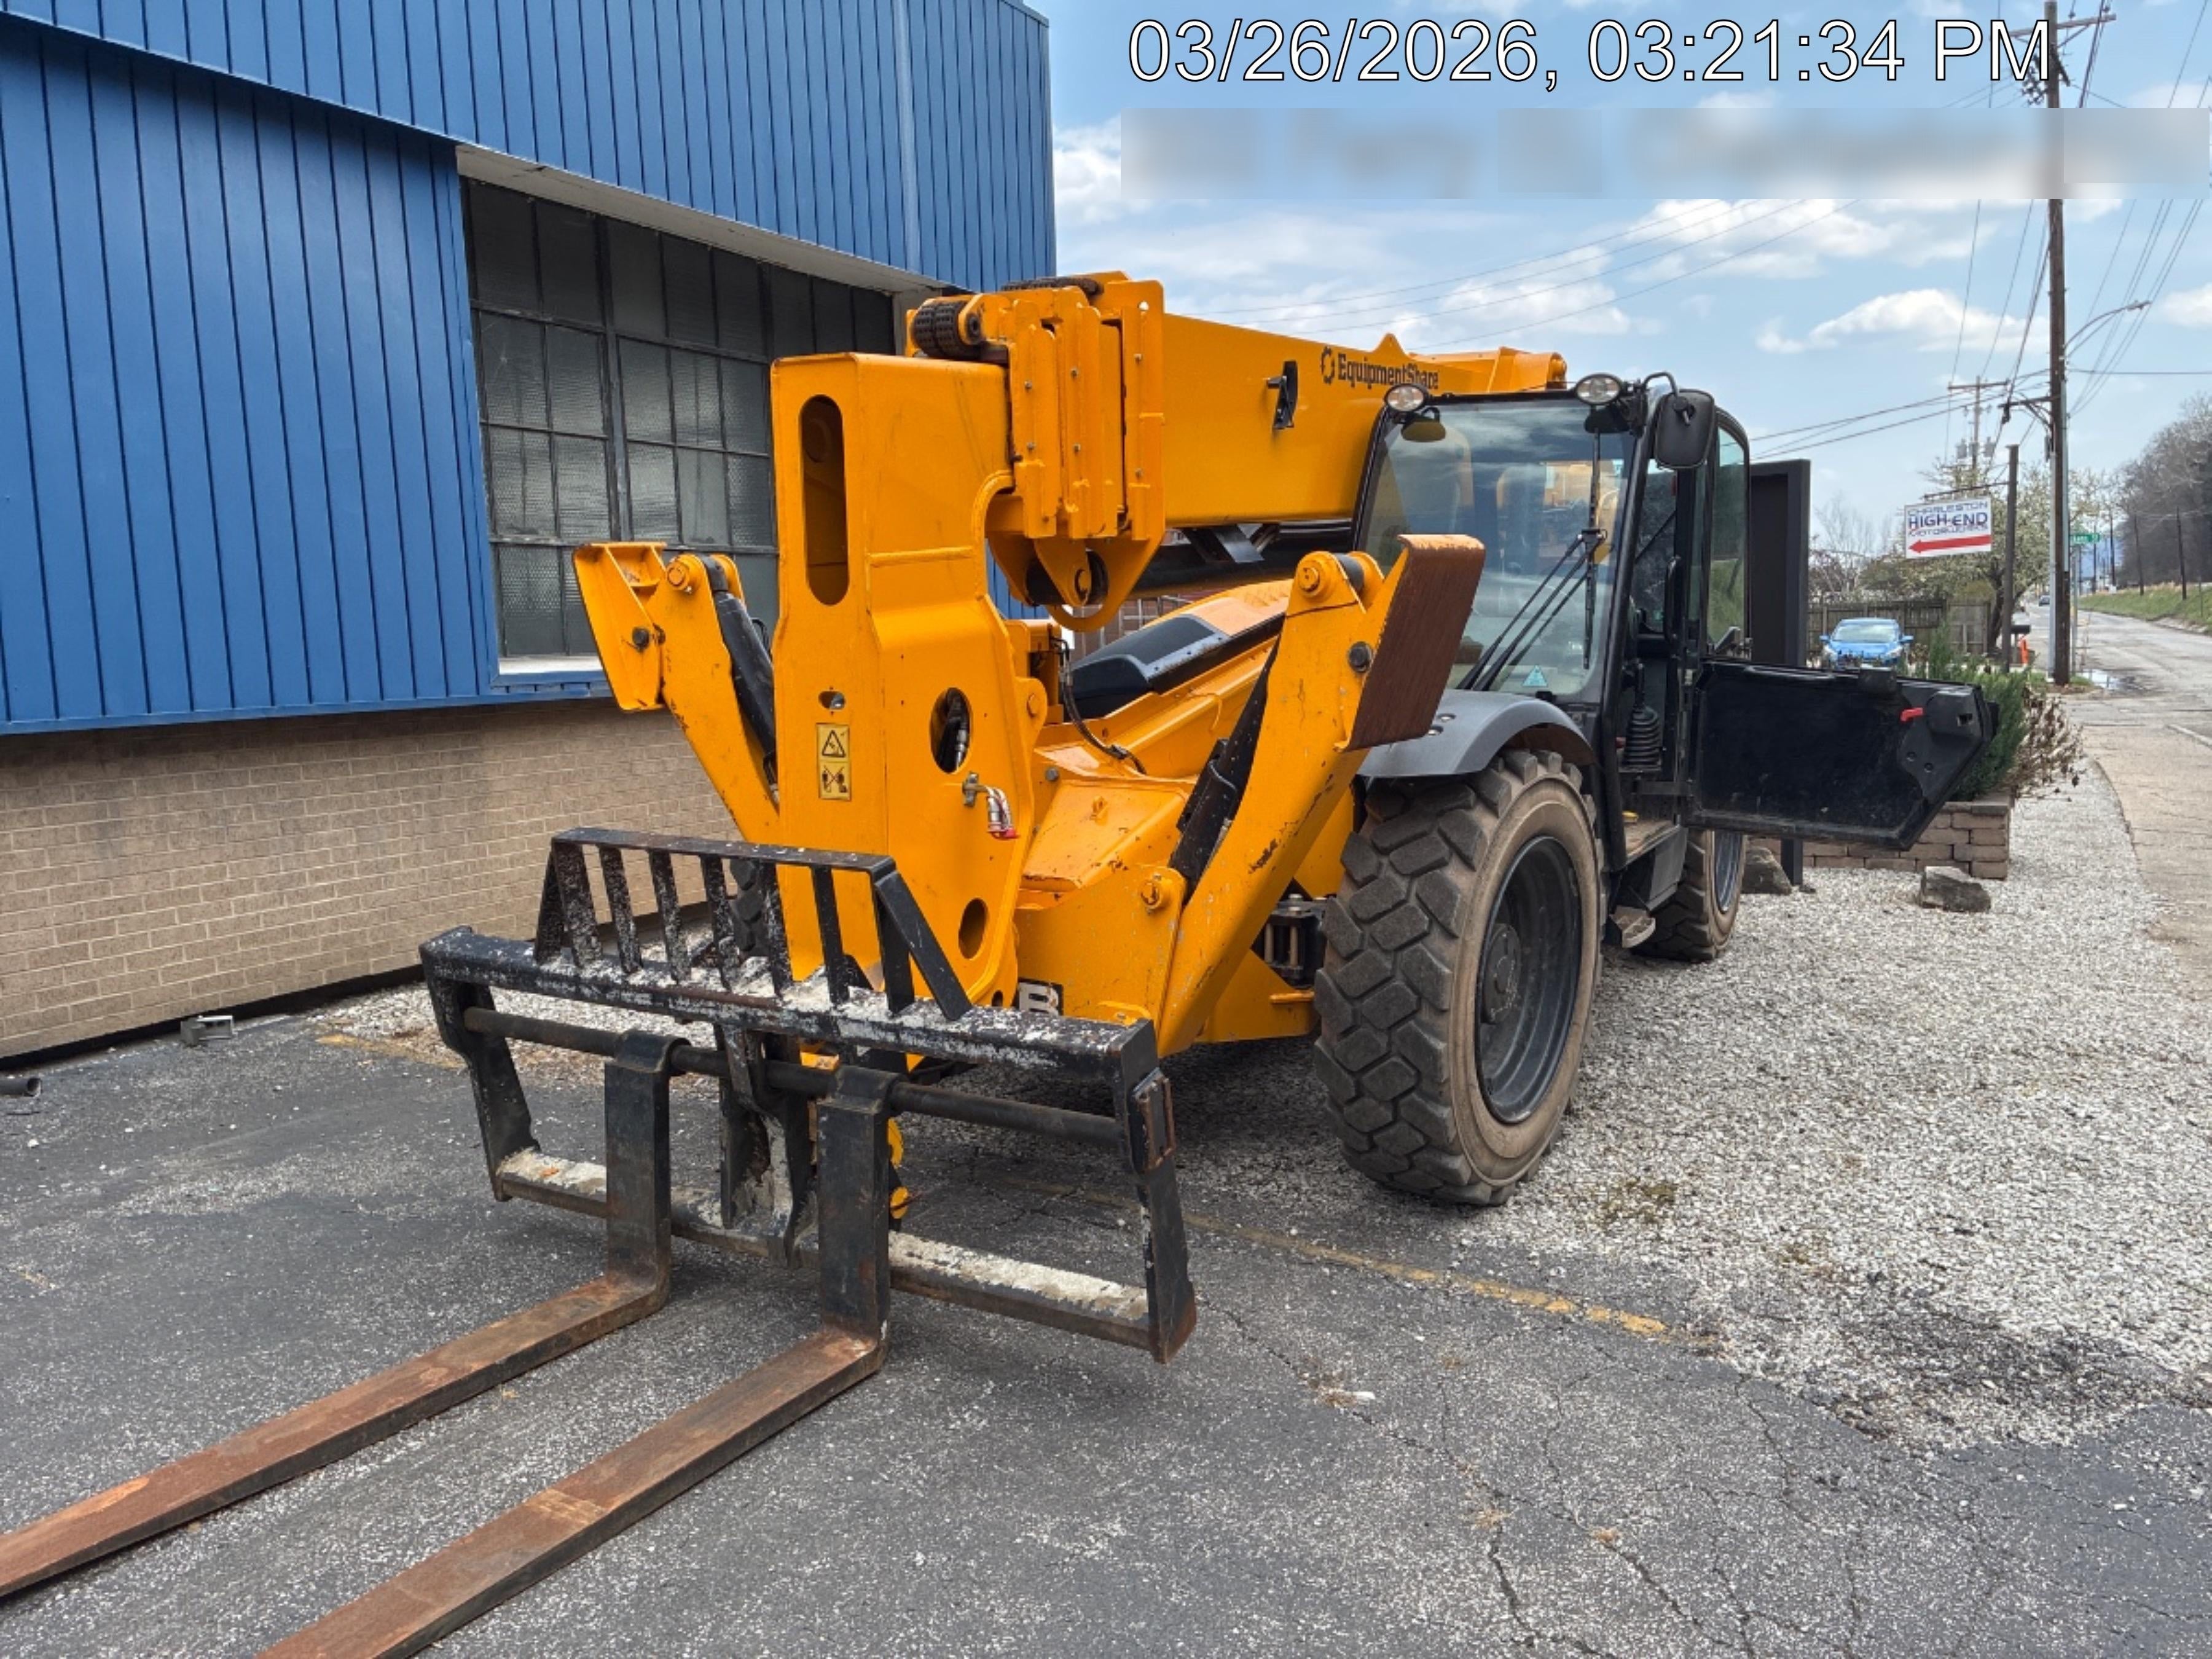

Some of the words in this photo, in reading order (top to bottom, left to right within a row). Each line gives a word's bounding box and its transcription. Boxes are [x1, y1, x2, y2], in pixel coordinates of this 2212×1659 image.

[1338, 353, 1438, 390] EquipmentShare
[1908, 501, 1988, 516] CHARLESTON
[1908, 512, 1988, 529] HIGH-END
